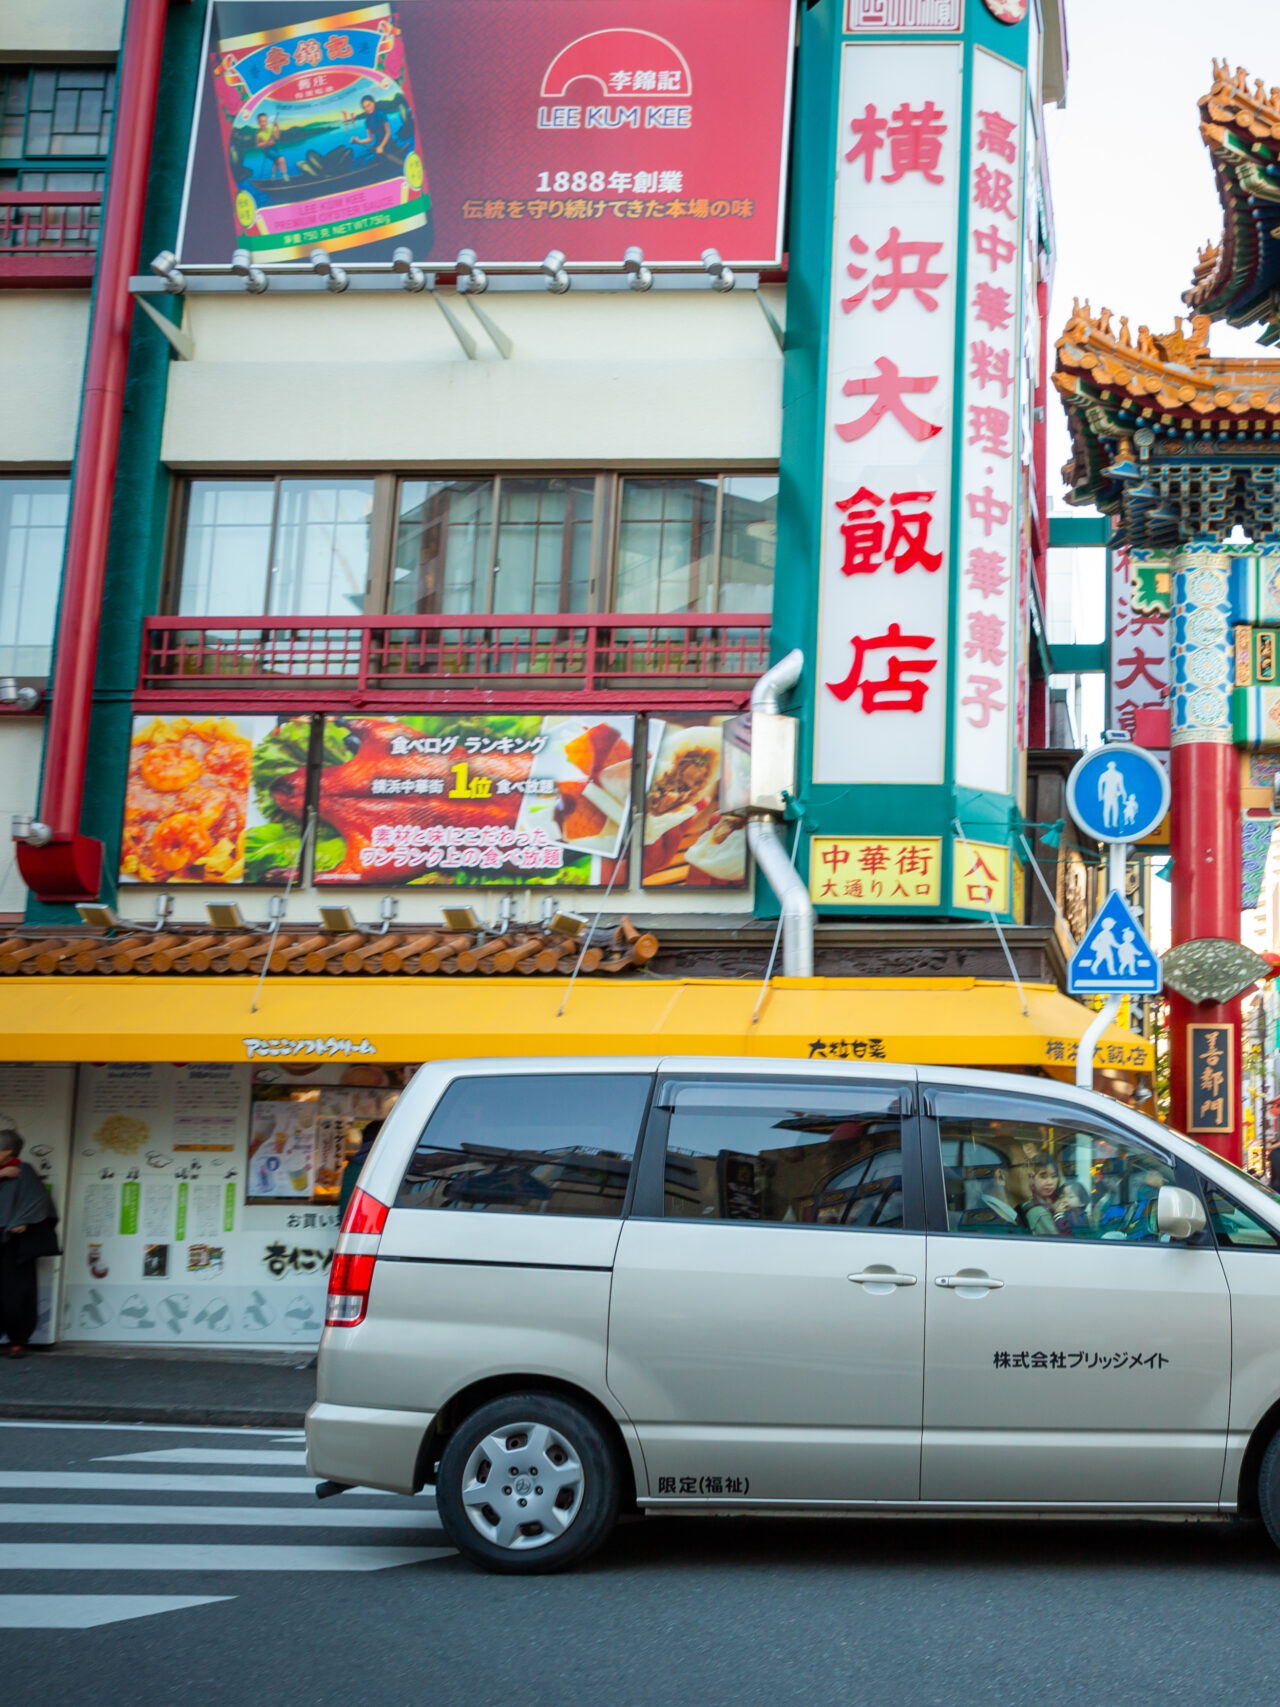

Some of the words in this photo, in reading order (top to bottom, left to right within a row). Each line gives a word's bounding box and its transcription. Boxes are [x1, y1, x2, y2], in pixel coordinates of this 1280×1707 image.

[265, 34, 353, 75] 李錦記
[608, 70, 681, 91] 李錦記
[537, 105, 582, 129] LEE
[585, 105, 640, 129] KUM
[645, 105, 692, 129] KEE
[535, 170, 683, 193] 1888年創業
[461, 198, 754, 220] 伝統を守り続けてきた本場の味
[826, 101, 948, 716] 横浜大飯店
[390, 736, 456, 755] 食べログ
[464, 736, 548, 755] ランキング
[372, 779, 444, 795] 横浜中華街
[448, 762, 492, 799] 1位
[371, 825, 550, 847] 素材と味にこだわった
[359, 847, 564, 870] ワンランク上の食べ放題
[821, 844, 933, 877] 中華街
[962, 850, 998, 904] 入口
[819, 880, 932, 900] 大通り入口
[808, 1036, 888, 1060] 大粒甘栗
[993, 1350, 1169, 1370] 株式会社ブリッジメイト
[658, 1475, 750, 1495] 限定(福祉)
